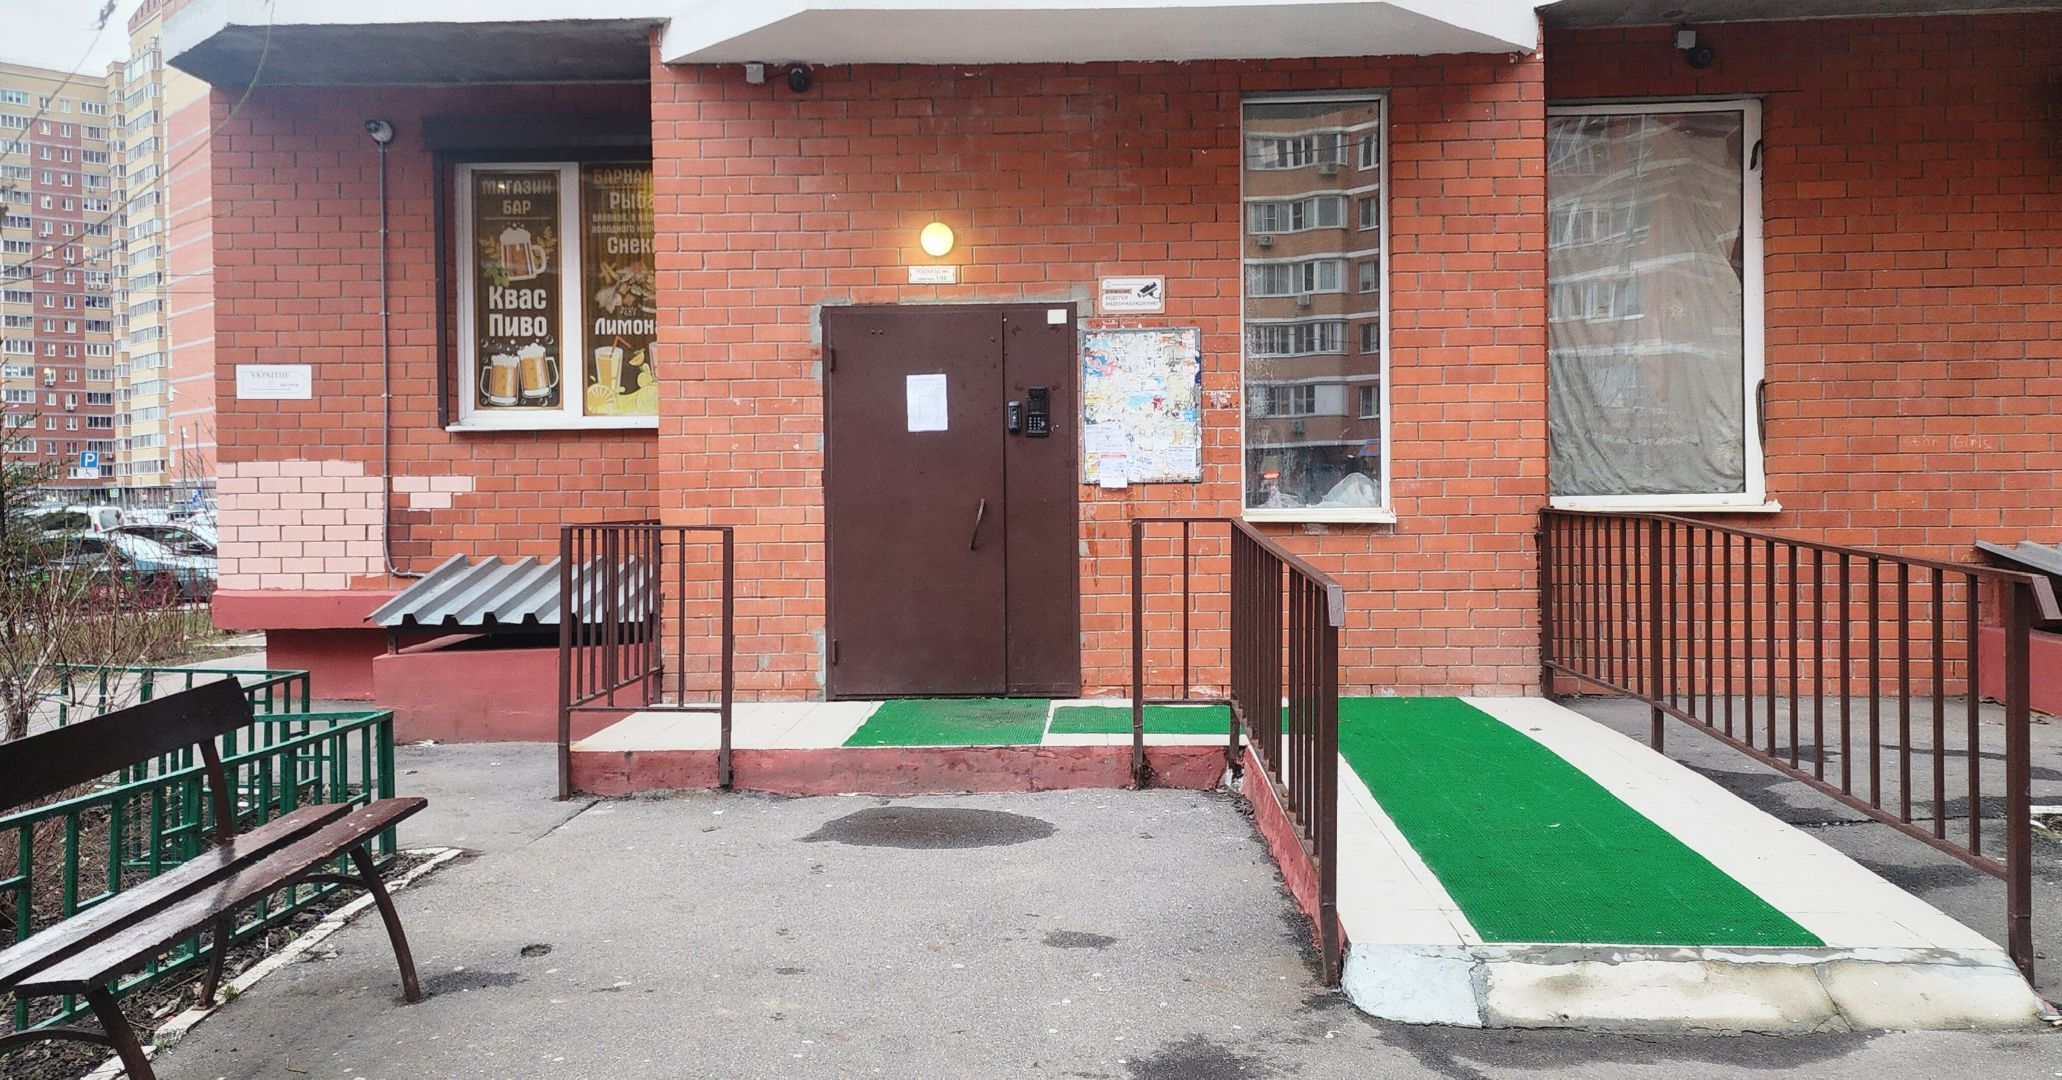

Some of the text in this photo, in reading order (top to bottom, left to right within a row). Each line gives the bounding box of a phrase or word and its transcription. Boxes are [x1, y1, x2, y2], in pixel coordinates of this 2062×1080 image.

[481, 179, 552, 195] МАГАЗИН
[502, 199, 531, 215] БАР
[488, 286, 547, 310] Квас
[488, 313, 547, 337] Пиво
[595, 317, 658, 335] Лимон
[249, 370, 289, 379] УКРЫТИЕ
[84, 454, 95, 467] P
